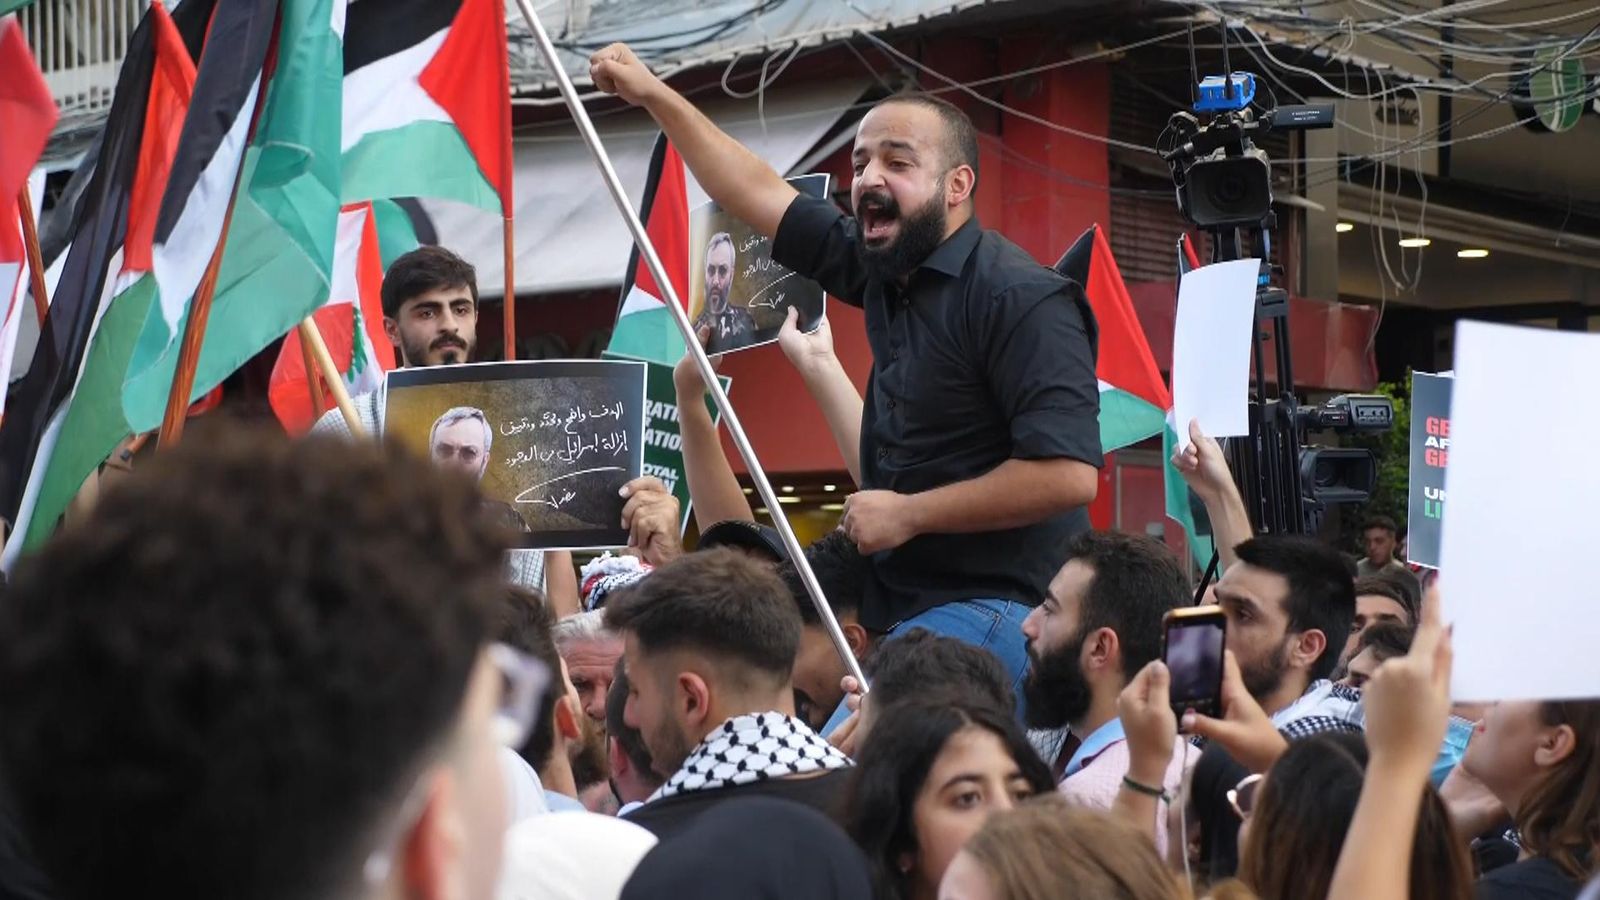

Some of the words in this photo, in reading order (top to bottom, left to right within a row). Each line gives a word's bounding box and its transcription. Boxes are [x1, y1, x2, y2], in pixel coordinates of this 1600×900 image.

[564, 405, 586, 435] واضح
[588, 401, 624, 420] الهدف
[500, 417, 536, 436] ودقيق
[557, 433, 598, 465] إسرائيل
[601, 430, 628, 457] إزالة
[505, 444, 538, 468] الوجود
[540, 449, 554, 461] من
[643, 463, 680, 481] OTAL
